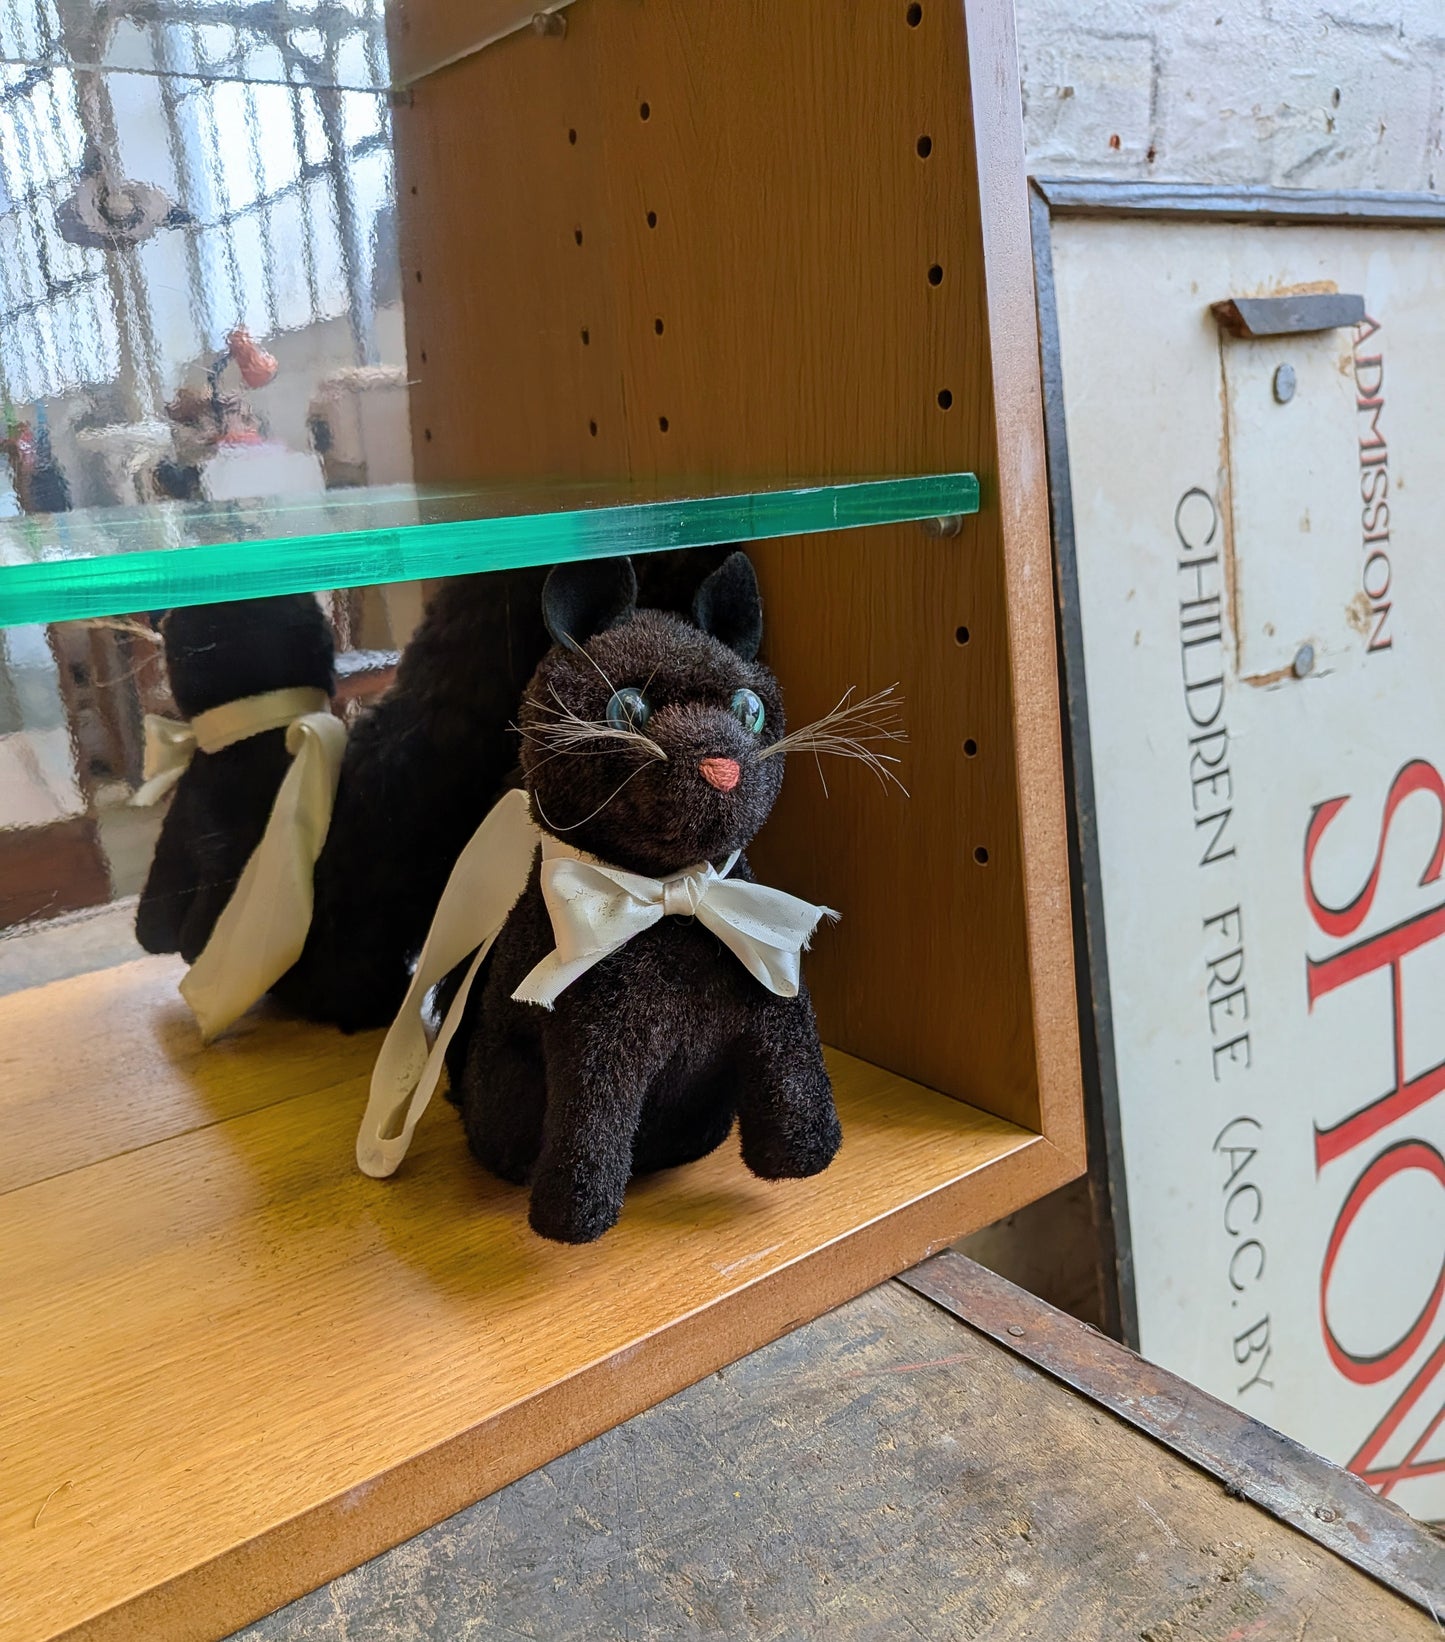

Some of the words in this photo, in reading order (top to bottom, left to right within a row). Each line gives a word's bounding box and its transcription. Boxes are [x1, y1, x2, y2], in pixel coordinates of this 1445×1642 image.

[1353, 313, 1393, 656] ADMISSION
[1174, 486, 1237, 868] CHILDREN
[1202, 904, 1251, 1083] FREE
[1212, 1115, 1266, 1308] (ACC.
[1233, 1314, 1275, 1400] BY
